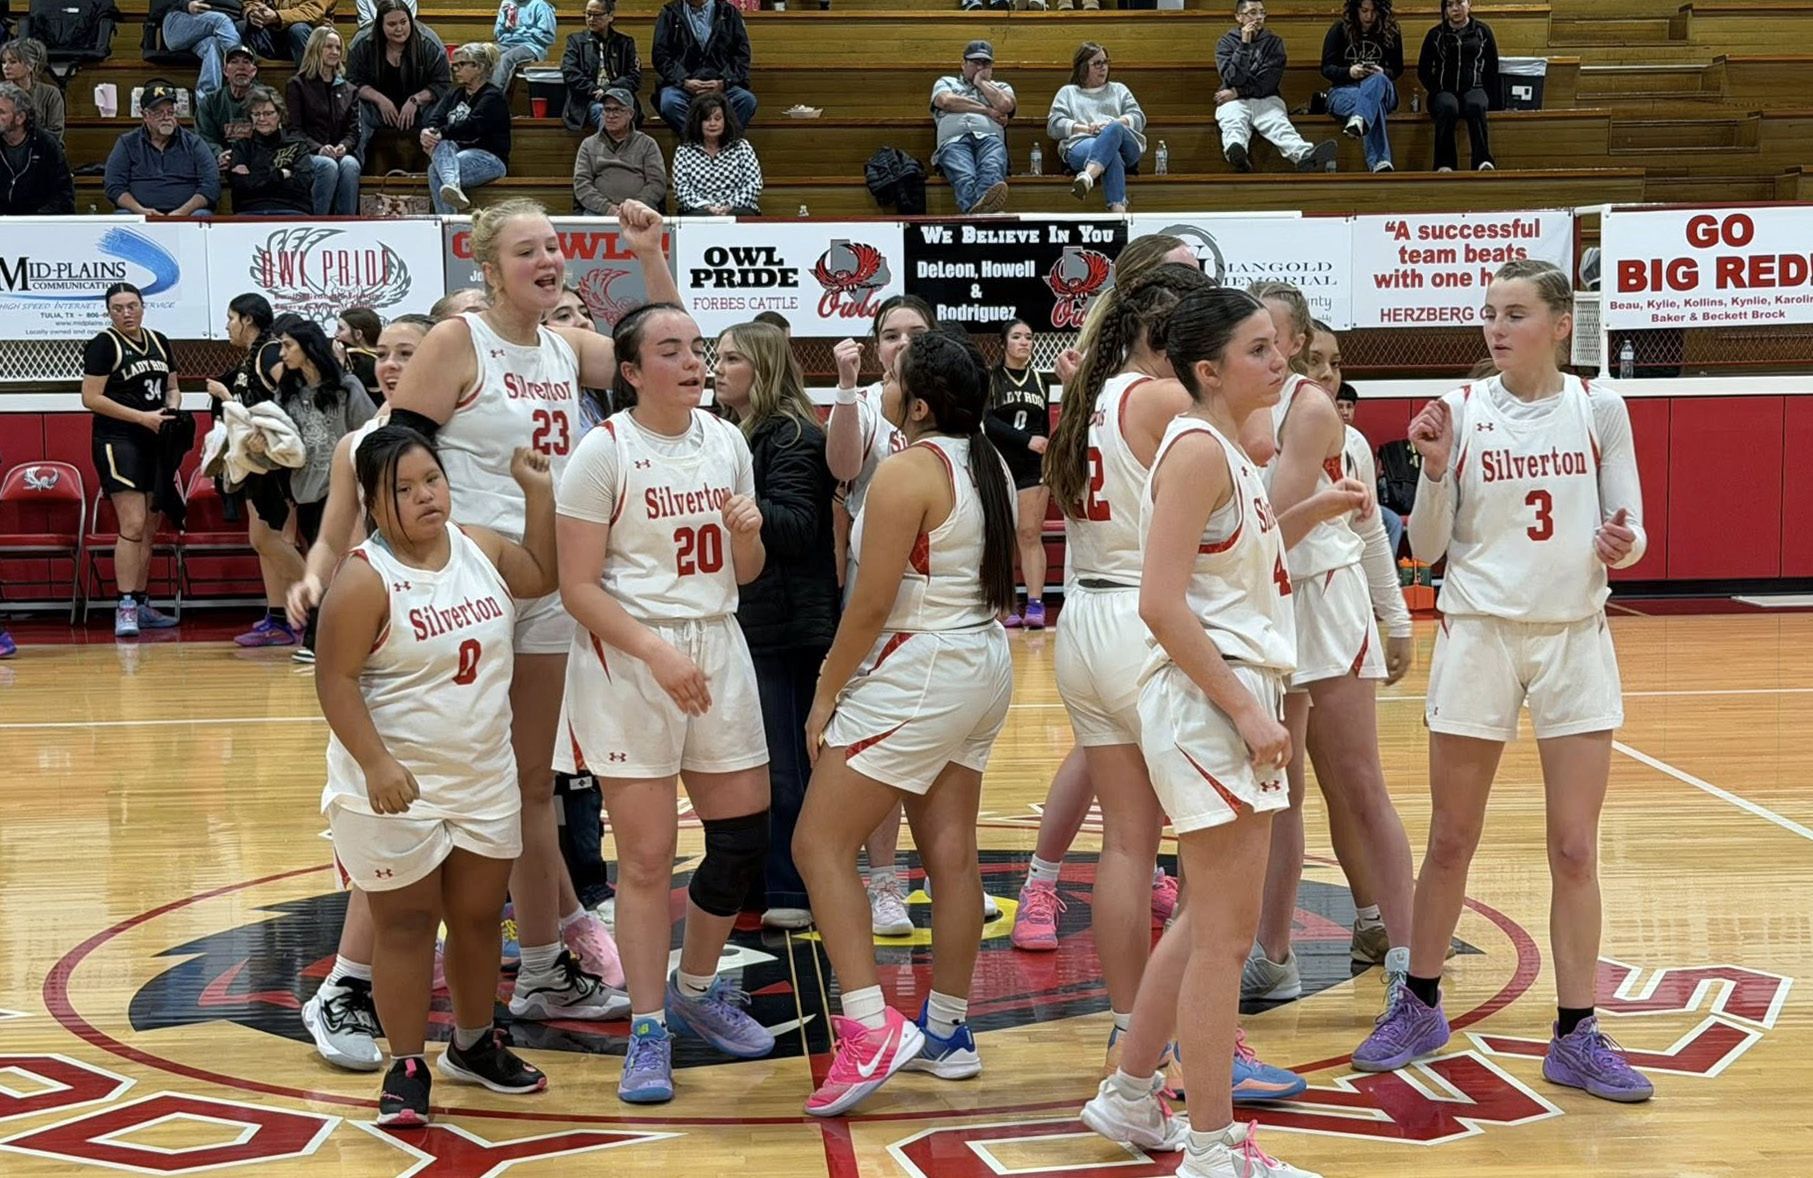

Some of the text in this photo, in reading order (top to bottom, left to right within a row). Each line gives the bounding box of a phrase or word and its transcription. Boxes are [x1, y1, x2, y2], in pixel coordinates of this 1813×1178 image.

[1418, 218, 1540, 240] successful
[1686, 213, 1754, 248] GO
[704, 246, 784, 267] OWL
[1399, 243, 1528, 264] team beats
[262, 248, 392, 288] OWL PRIDE
[917, 260, 1035, 279] DeLeon, Howell
[1216, 261, 1333, 272] MANGOLD
[1617, 257, 1699, 293] BIG
[32, 281, 118, 290] COMMUNICATIO
[690, 268, 799, 289] PRIDE
[1374, 268, 1424, 289] with
[1431, 272, 1473, 288] one
[970, 284, 982, 299] &
[693, 296, 799, 310] FORBES CATTLE
[817, 289, 881, 319] Owls
[936, 304, 1017, 323] Rodriguez
[1610, 301, 1644, 311] Beau,
[1646, 299, 1680, 311] Kylie,
[1684, 297, 1727, 309] Kollins,
[1731, 296, 1771, 308] Kynlie,
[1380, 307, 1475, 323] HERZBERG
[1651, 309, 1786, 323] Baker & Beckett Brock
[121, 360, 150, 381] LADY
[144, 378, 162, 401] 34
[1013, 410, 1028, 430] 0
[532, 408, 570, 456] 23
[1481, 445, 1587, 483] Silverton
[1525, 489, 1554, 541] 3
[673, 523, 724, 578] 20
[1273, 540, 1293, 597] 4
[409, 596, 504, 642] Silverton
[452, 638, 482, 685] 0
